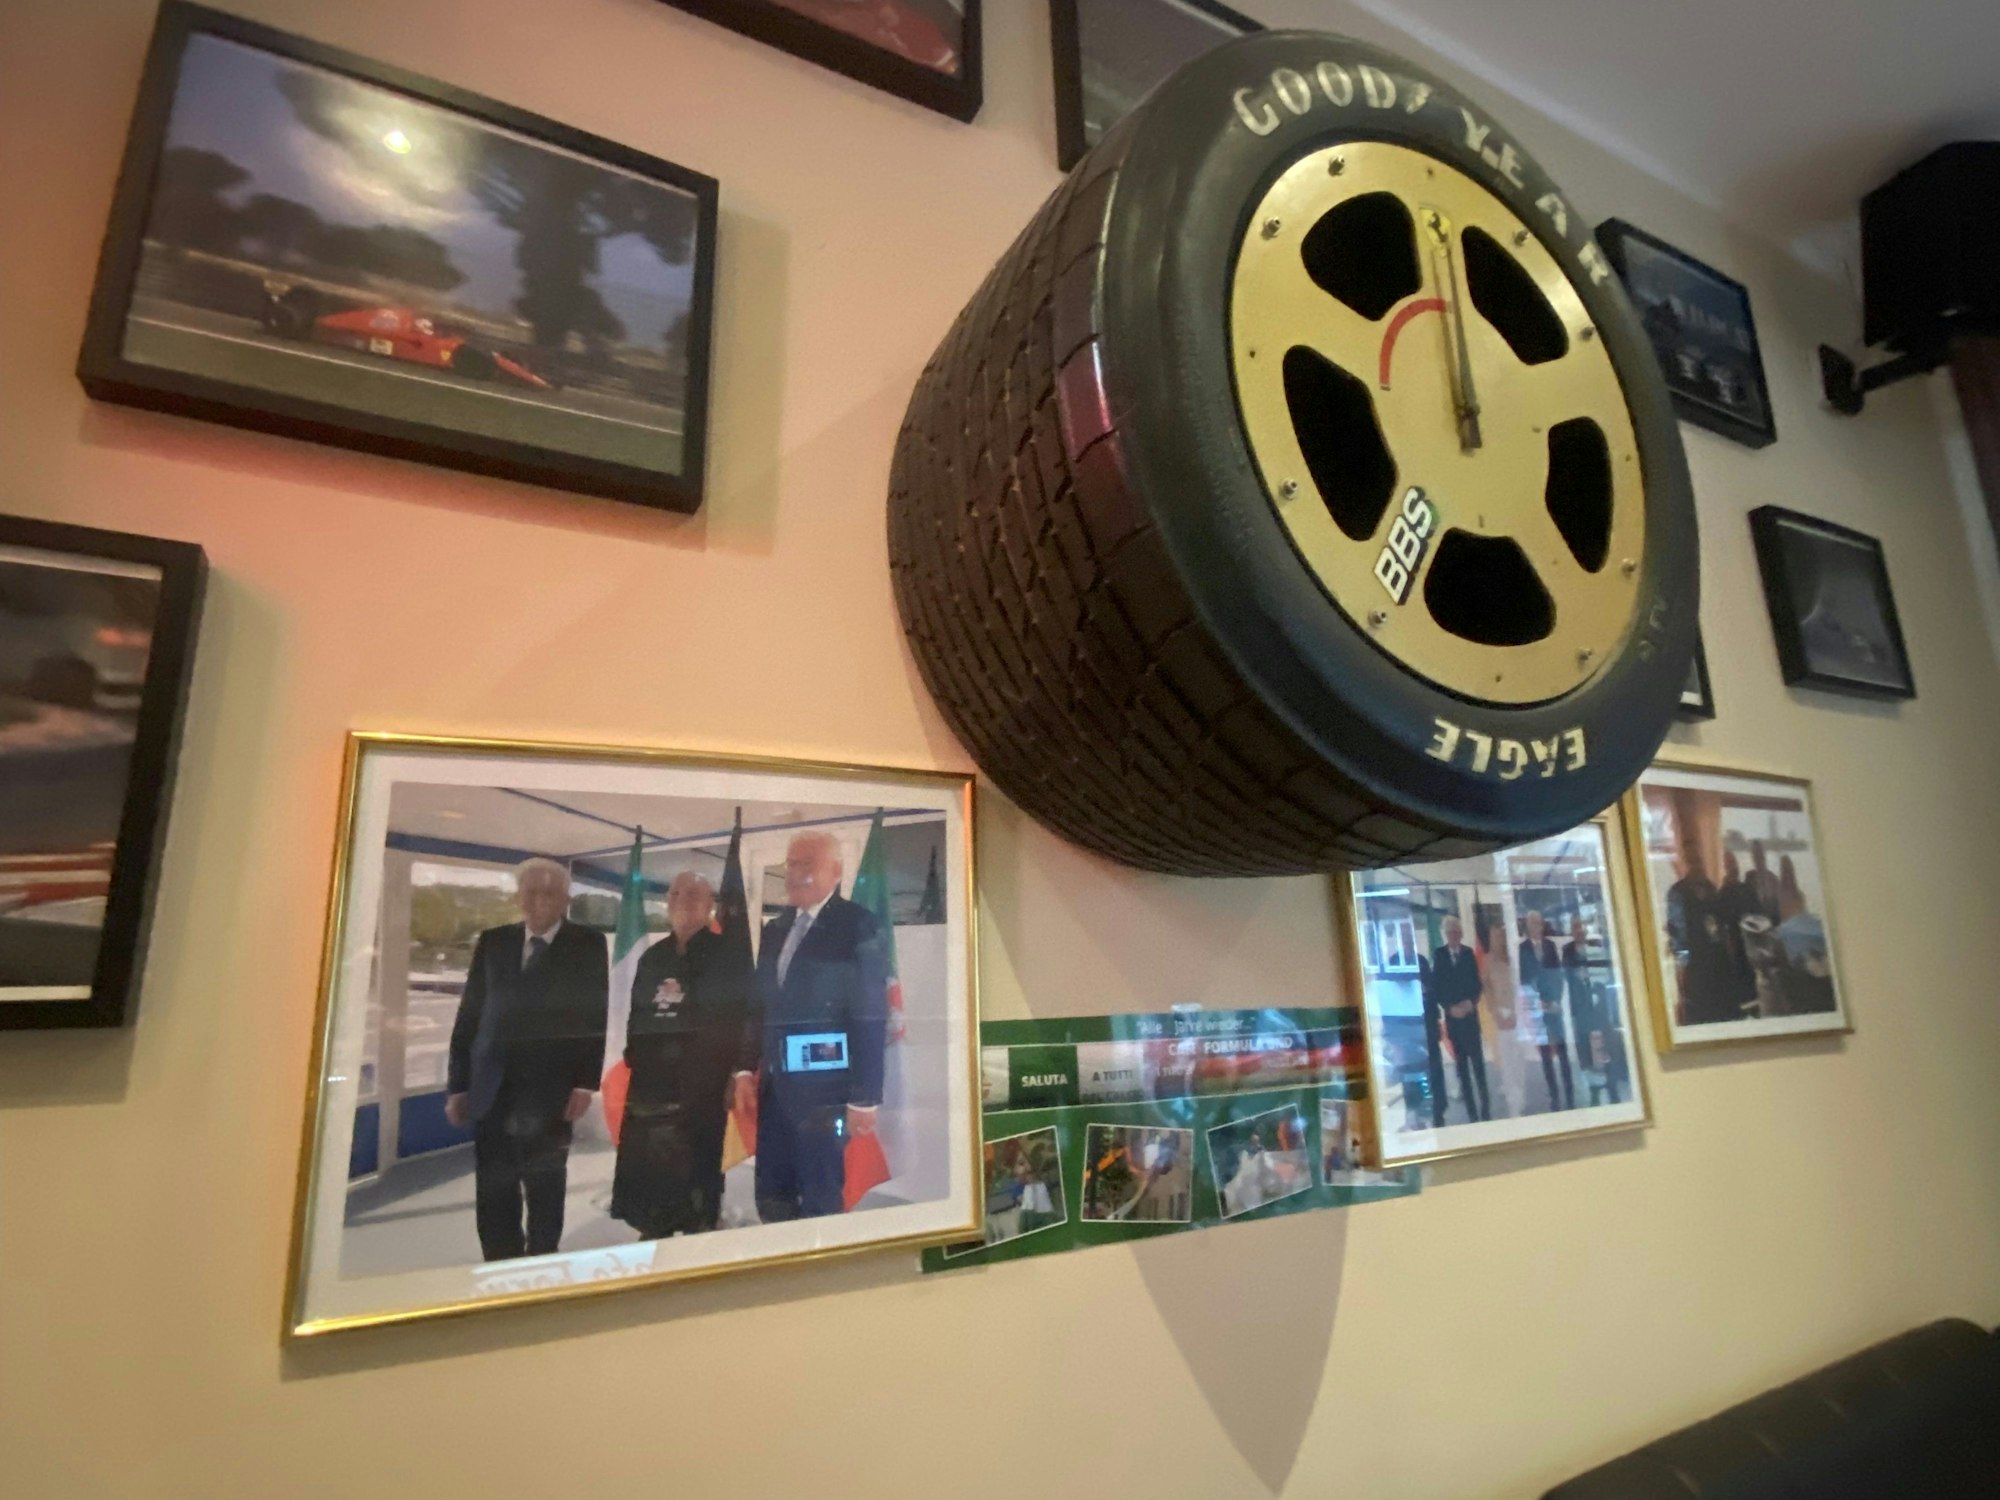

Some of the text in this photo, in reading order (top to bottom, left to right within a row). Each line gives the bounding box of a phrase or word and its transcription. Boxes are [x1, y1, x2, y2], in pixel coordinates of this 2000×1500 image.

[1373, 485, 1437, 605] BBS
[1424, 717, 1588, 781] EAGLE
[1021, 1073, 1069, 1088] SALUTA
[1092, 1071, 1100, 1081] A
[1103, 1069, 1133, 1081] TUTTI
